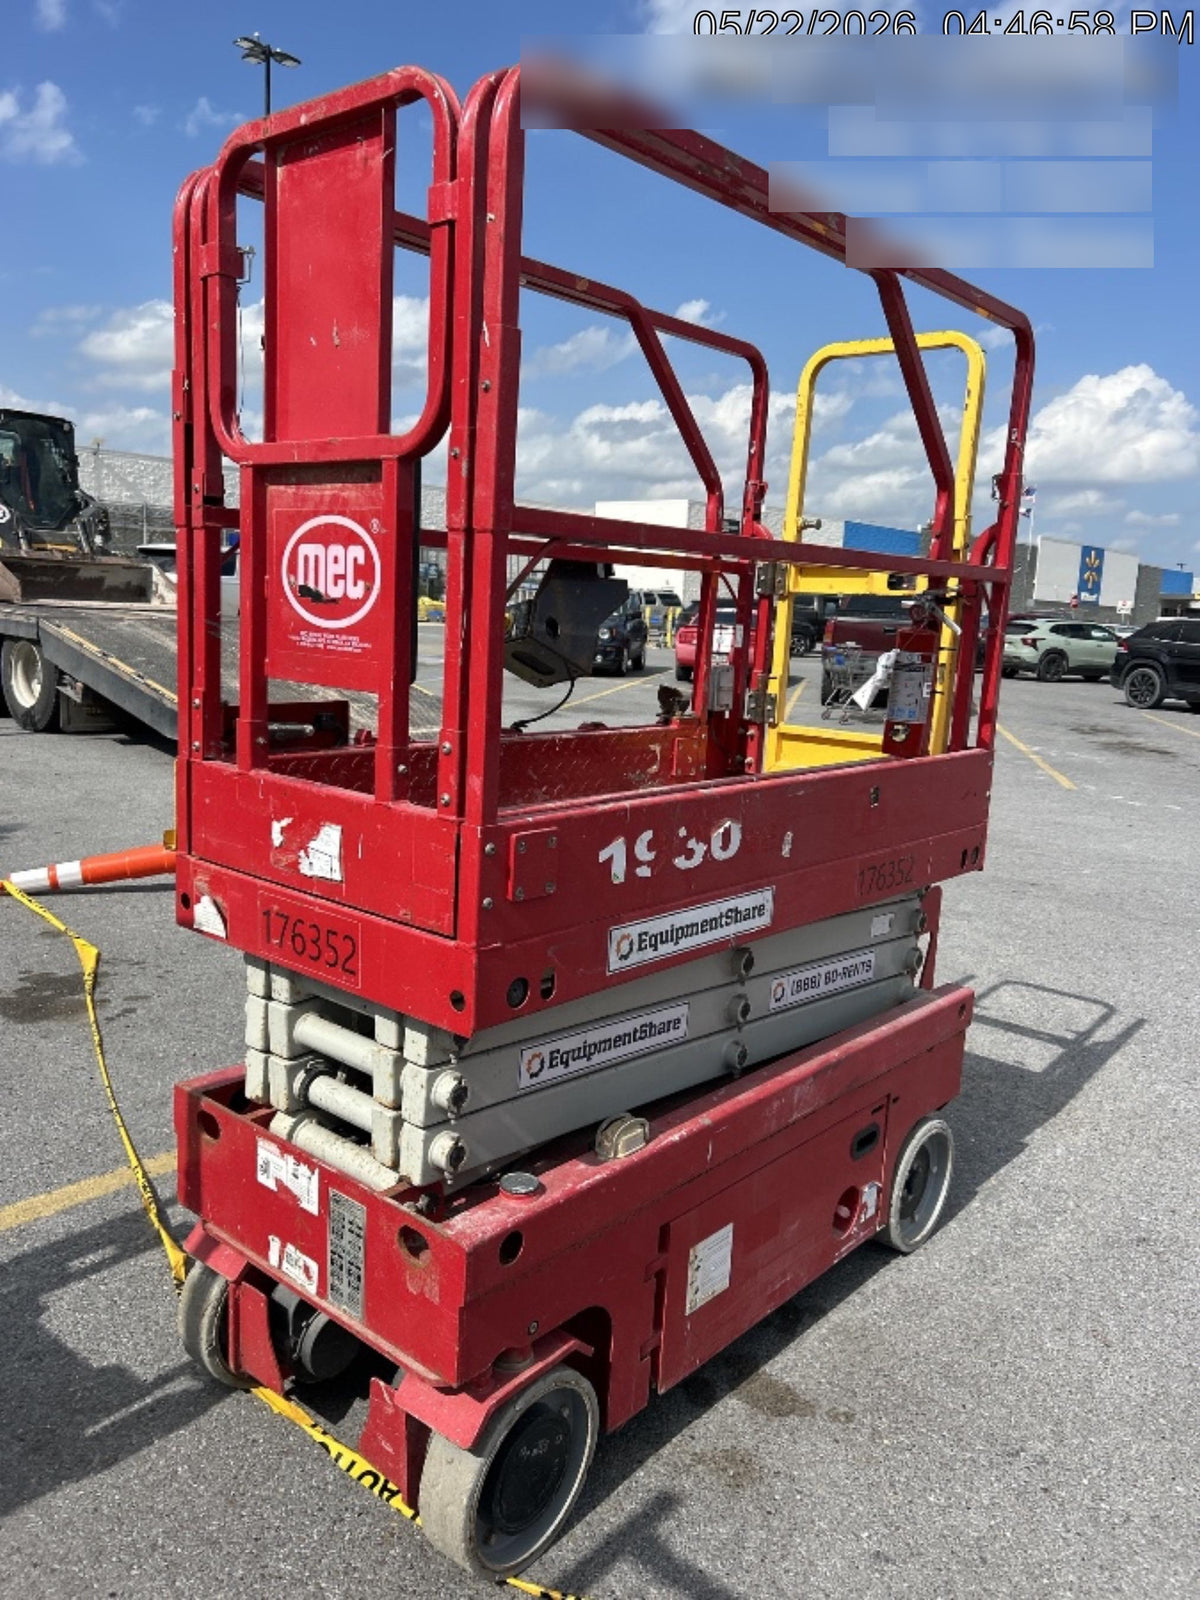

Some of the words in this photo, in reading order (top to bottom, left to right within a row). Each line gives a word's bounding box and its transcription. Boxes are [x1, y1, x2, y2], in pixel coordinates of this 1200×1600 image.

[858, 855, 915, 897] 176352
[262, 908, 357, 976] 176352
[636, 903, 766, 952] EquipmentShare
[547, 1016, 682, 1069] EquipmentShare
